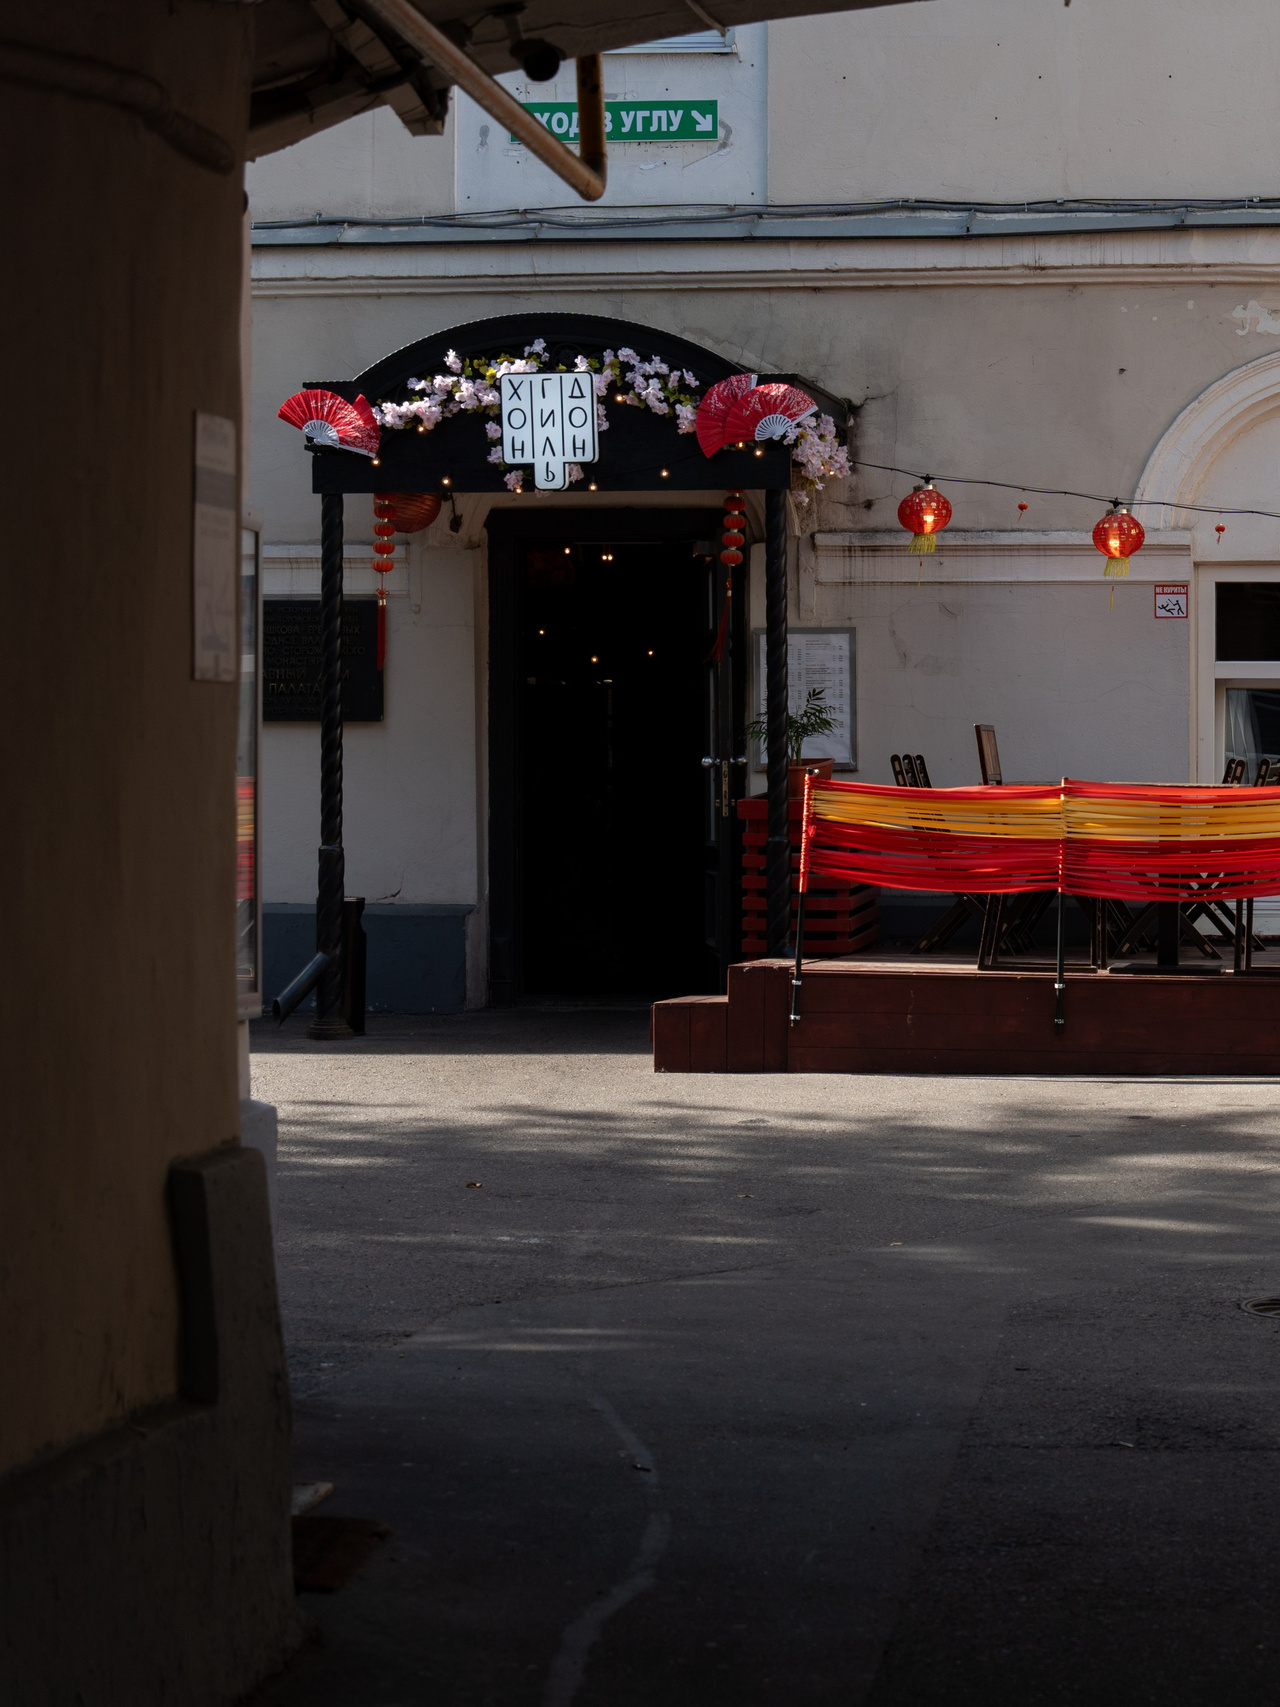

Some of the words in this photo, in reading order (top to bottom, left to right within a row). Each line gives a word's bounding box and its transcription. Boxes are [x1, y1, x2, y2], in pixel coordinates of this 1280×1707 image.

[534, 111, 580, 137] ХОД
[620, 109, 684, 133] УГЛУ
[264, 636, 297, 645] ОДНОЕ
[267, 657, 321, 665] МОНАСТЫР
[263, 667, 306, 680] АВНЫЙ
